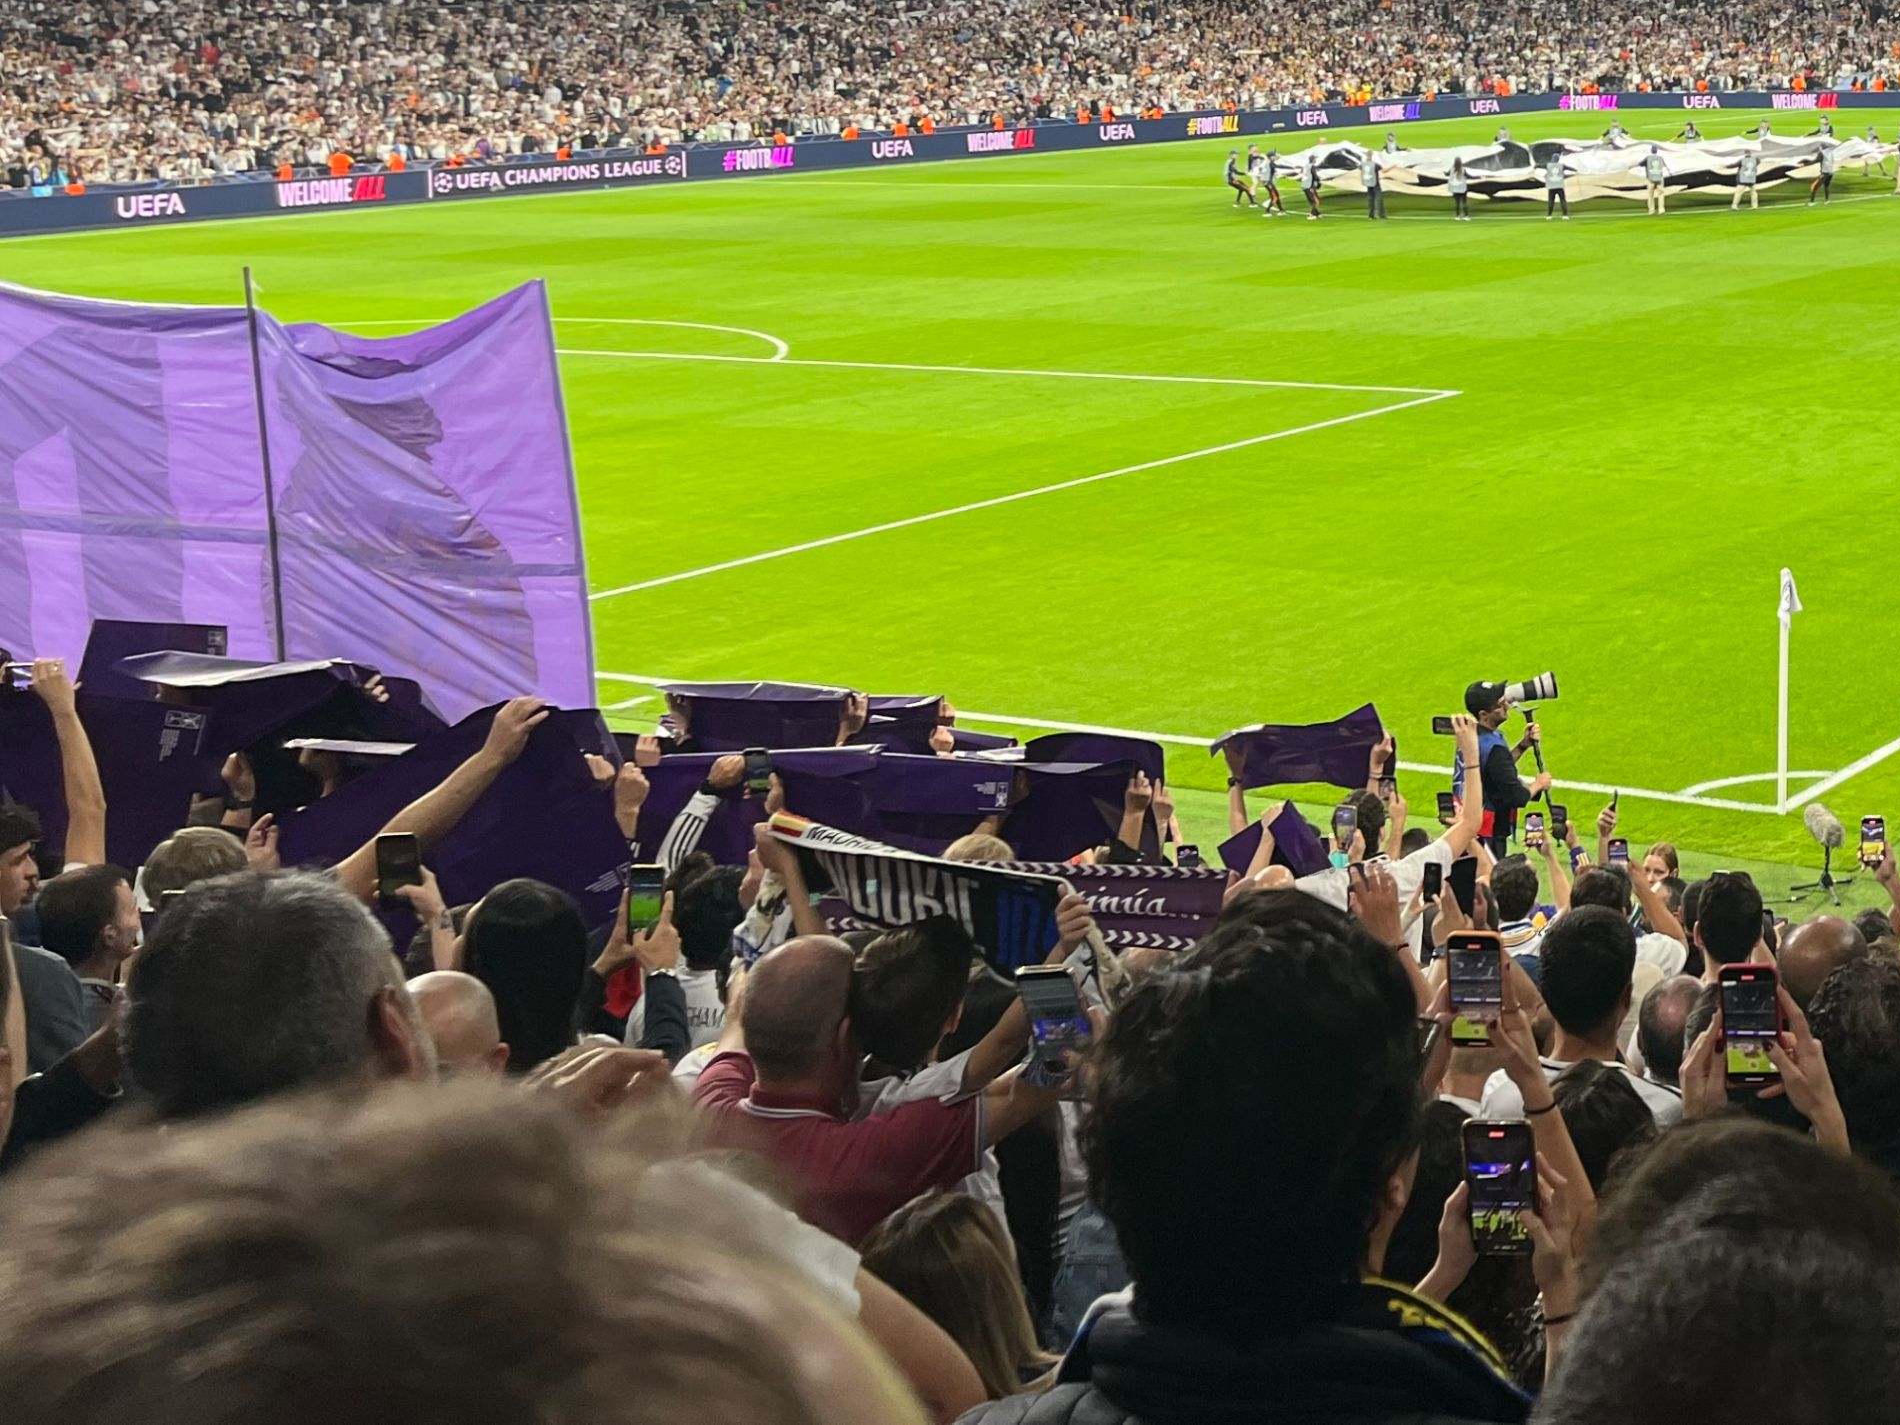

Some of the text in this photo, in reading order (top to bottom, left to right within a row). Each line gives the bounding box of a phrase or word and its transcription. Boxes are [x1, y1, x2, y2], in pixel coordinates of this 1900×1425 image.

[1470, 100, 1499, 114] UEFA
[1559, 95, 1618, 110] #FOOTBALL
[1683, 96, 1720, 109] UEFA
[1772, 93, 1838, 109] WELCOME ALL
[1297, 111, 1328, 126] UEFA
[1369, 103, 1421, 122] WELCOME ALL
[1100, 122, 1135, 141] UEFA
[1187, 115, 1238, 134] #FOOTBALL
[872, 139, 913, 158] UEFA
[967, 128, 1035, 152] WELCOME ALL
[722, 146, 794, 172] #FOOTBALL
[456, 158, 662, 189] UEFA CHAMPIONS LEAGUE
[278, 176, 386, 207] WELCOME ALL
[117, 193, 186, 218] UEFA
